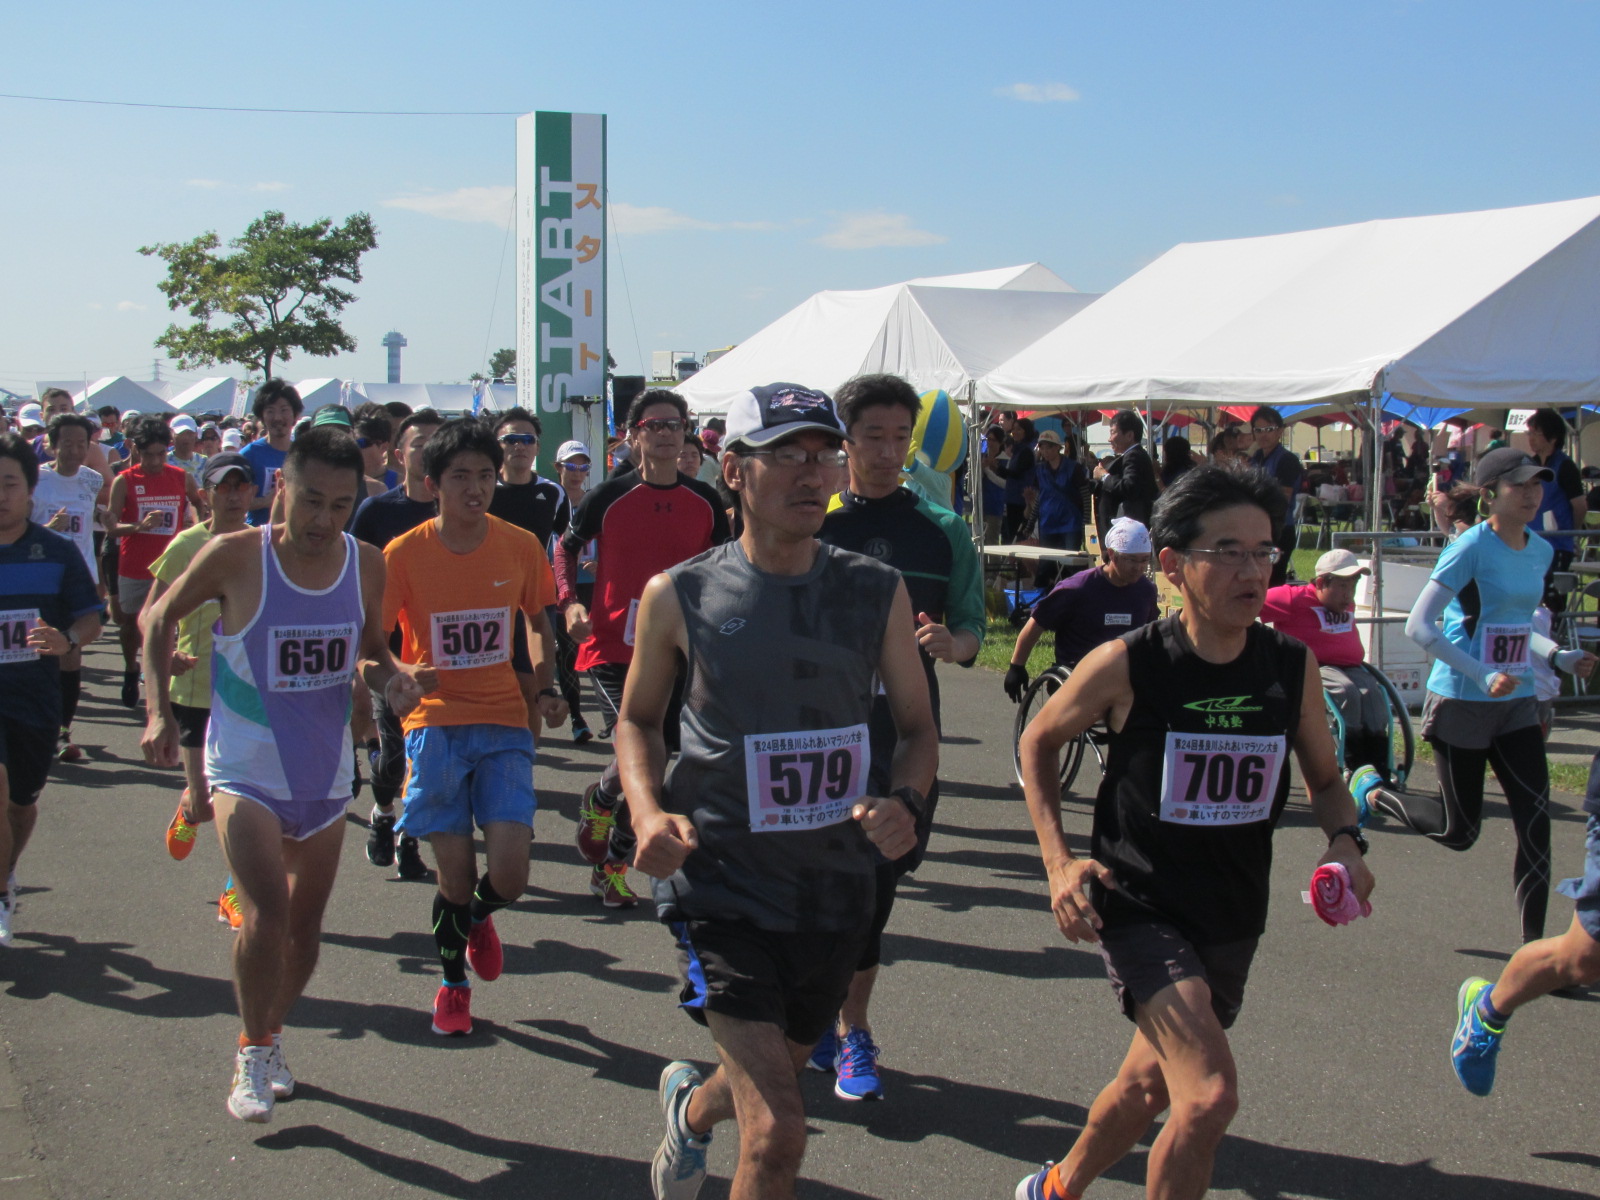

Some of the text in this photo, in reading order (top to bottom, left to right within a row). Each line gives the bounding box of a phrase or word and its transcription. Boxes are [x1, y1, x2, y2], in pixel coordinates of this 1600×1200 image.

[541, 166, 573, 413] START
[575, 183, 602, 371] スタート
[0, 621, 26, 650] 14
[442, 620, 500, 655] 502
[1492, 635, 1526, 663] 877
[279, 637, 347, 675] 650
[753, 731, 863, 752] 第24回長良川ふれあいマラソン大会
[1174, 738, 1278, 753] 第24回長良川ふれあいマラソン大会
[769, 749, 853, 806] 579
[1183, 753, 1266, 803] 706
[780, 805, 851, 826] 車いすのマツナ
[1188, 807, 1265, 821] 車いすのマツナガ
